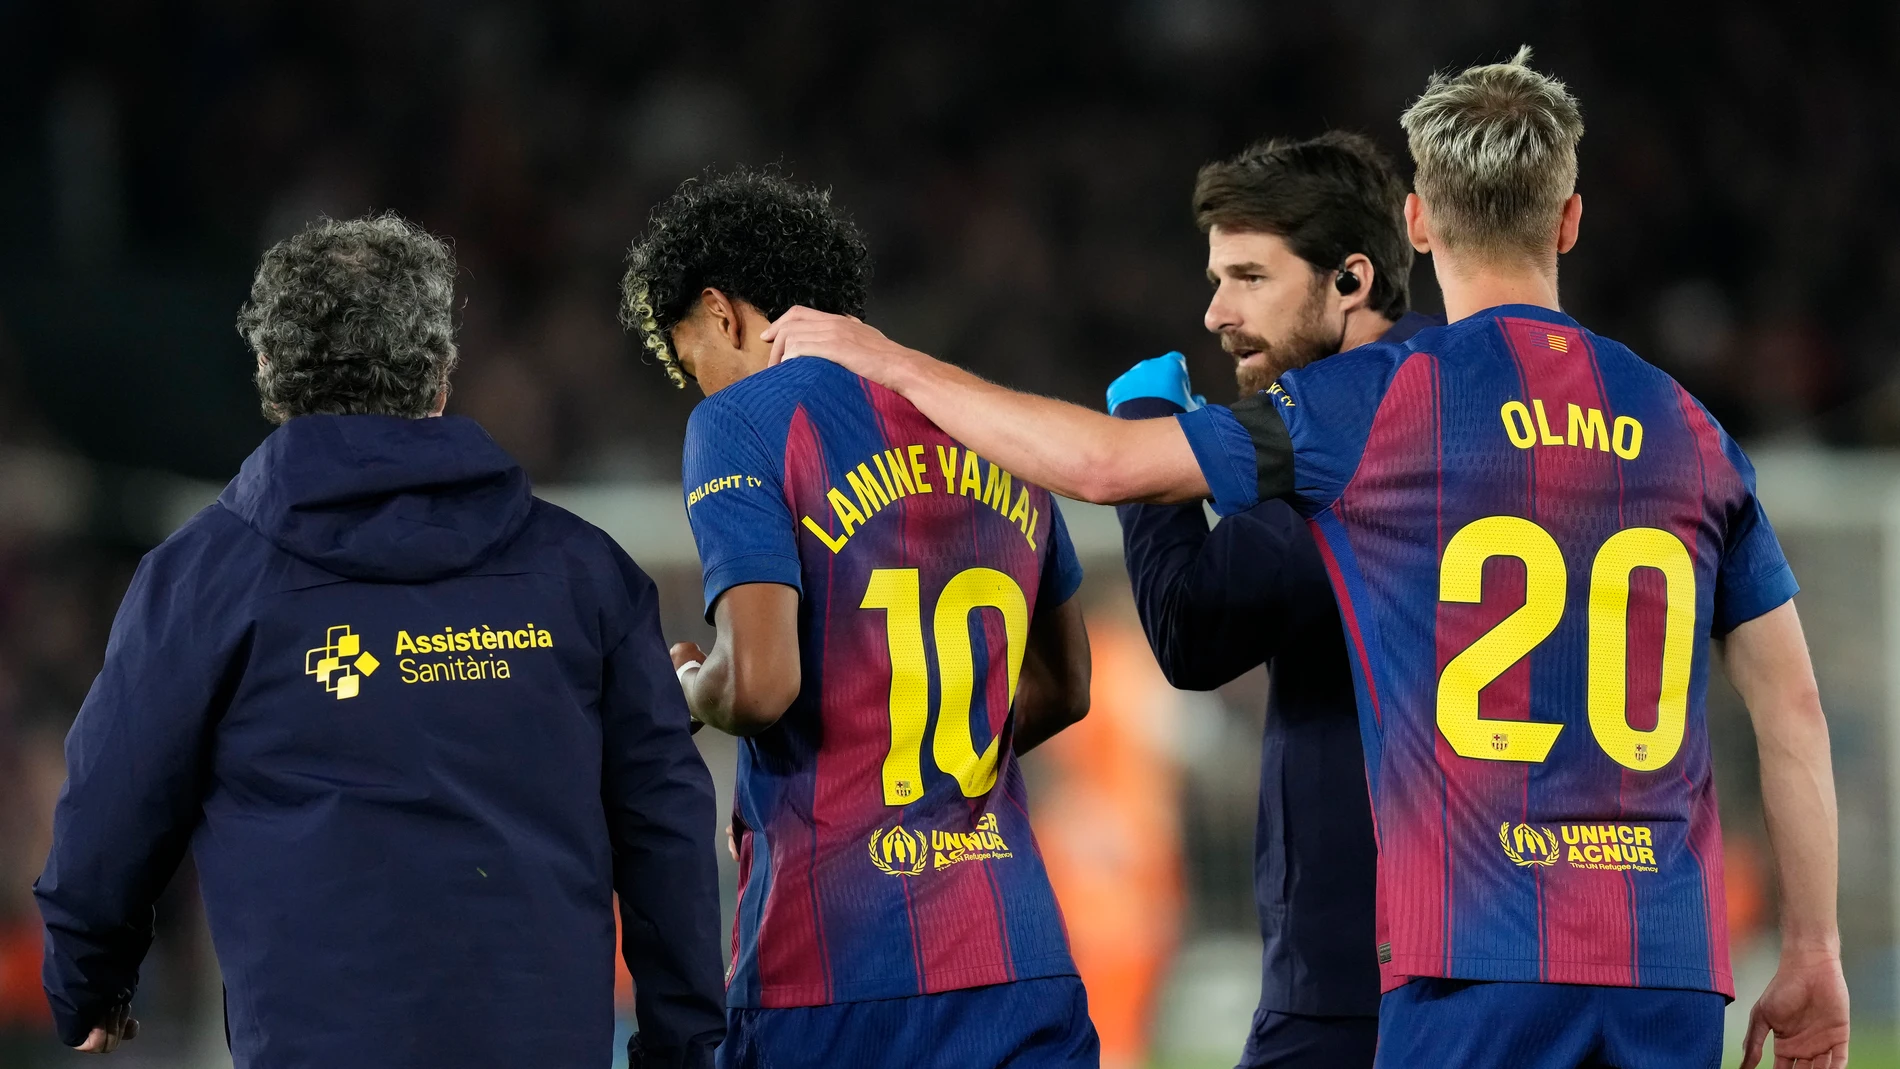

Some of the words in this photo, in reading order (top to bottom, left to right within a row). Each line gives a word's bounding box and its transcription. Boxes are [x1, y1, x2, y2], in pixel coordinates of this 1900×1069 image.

[1500, 399, 1643, 460] OLMO
[746, 475, 762, 488] tv
[801, 444, 932, 554] LAMINE
[936, 445, 1038, 552] YAMAL
[395, 623, 553, 656] Assistència
[1435, 515, 1696, 772] 20
[399, 653, 511, 684] Sanitària
[859, 567, 1028, 806] 10
[1561, 825, 1652, 846] UNHCR
[1567, 844, 1657, 865] ACNUR
[1600, 863, 1631, 872] Refugee
[1632, 863, 1658, 873] Agency
